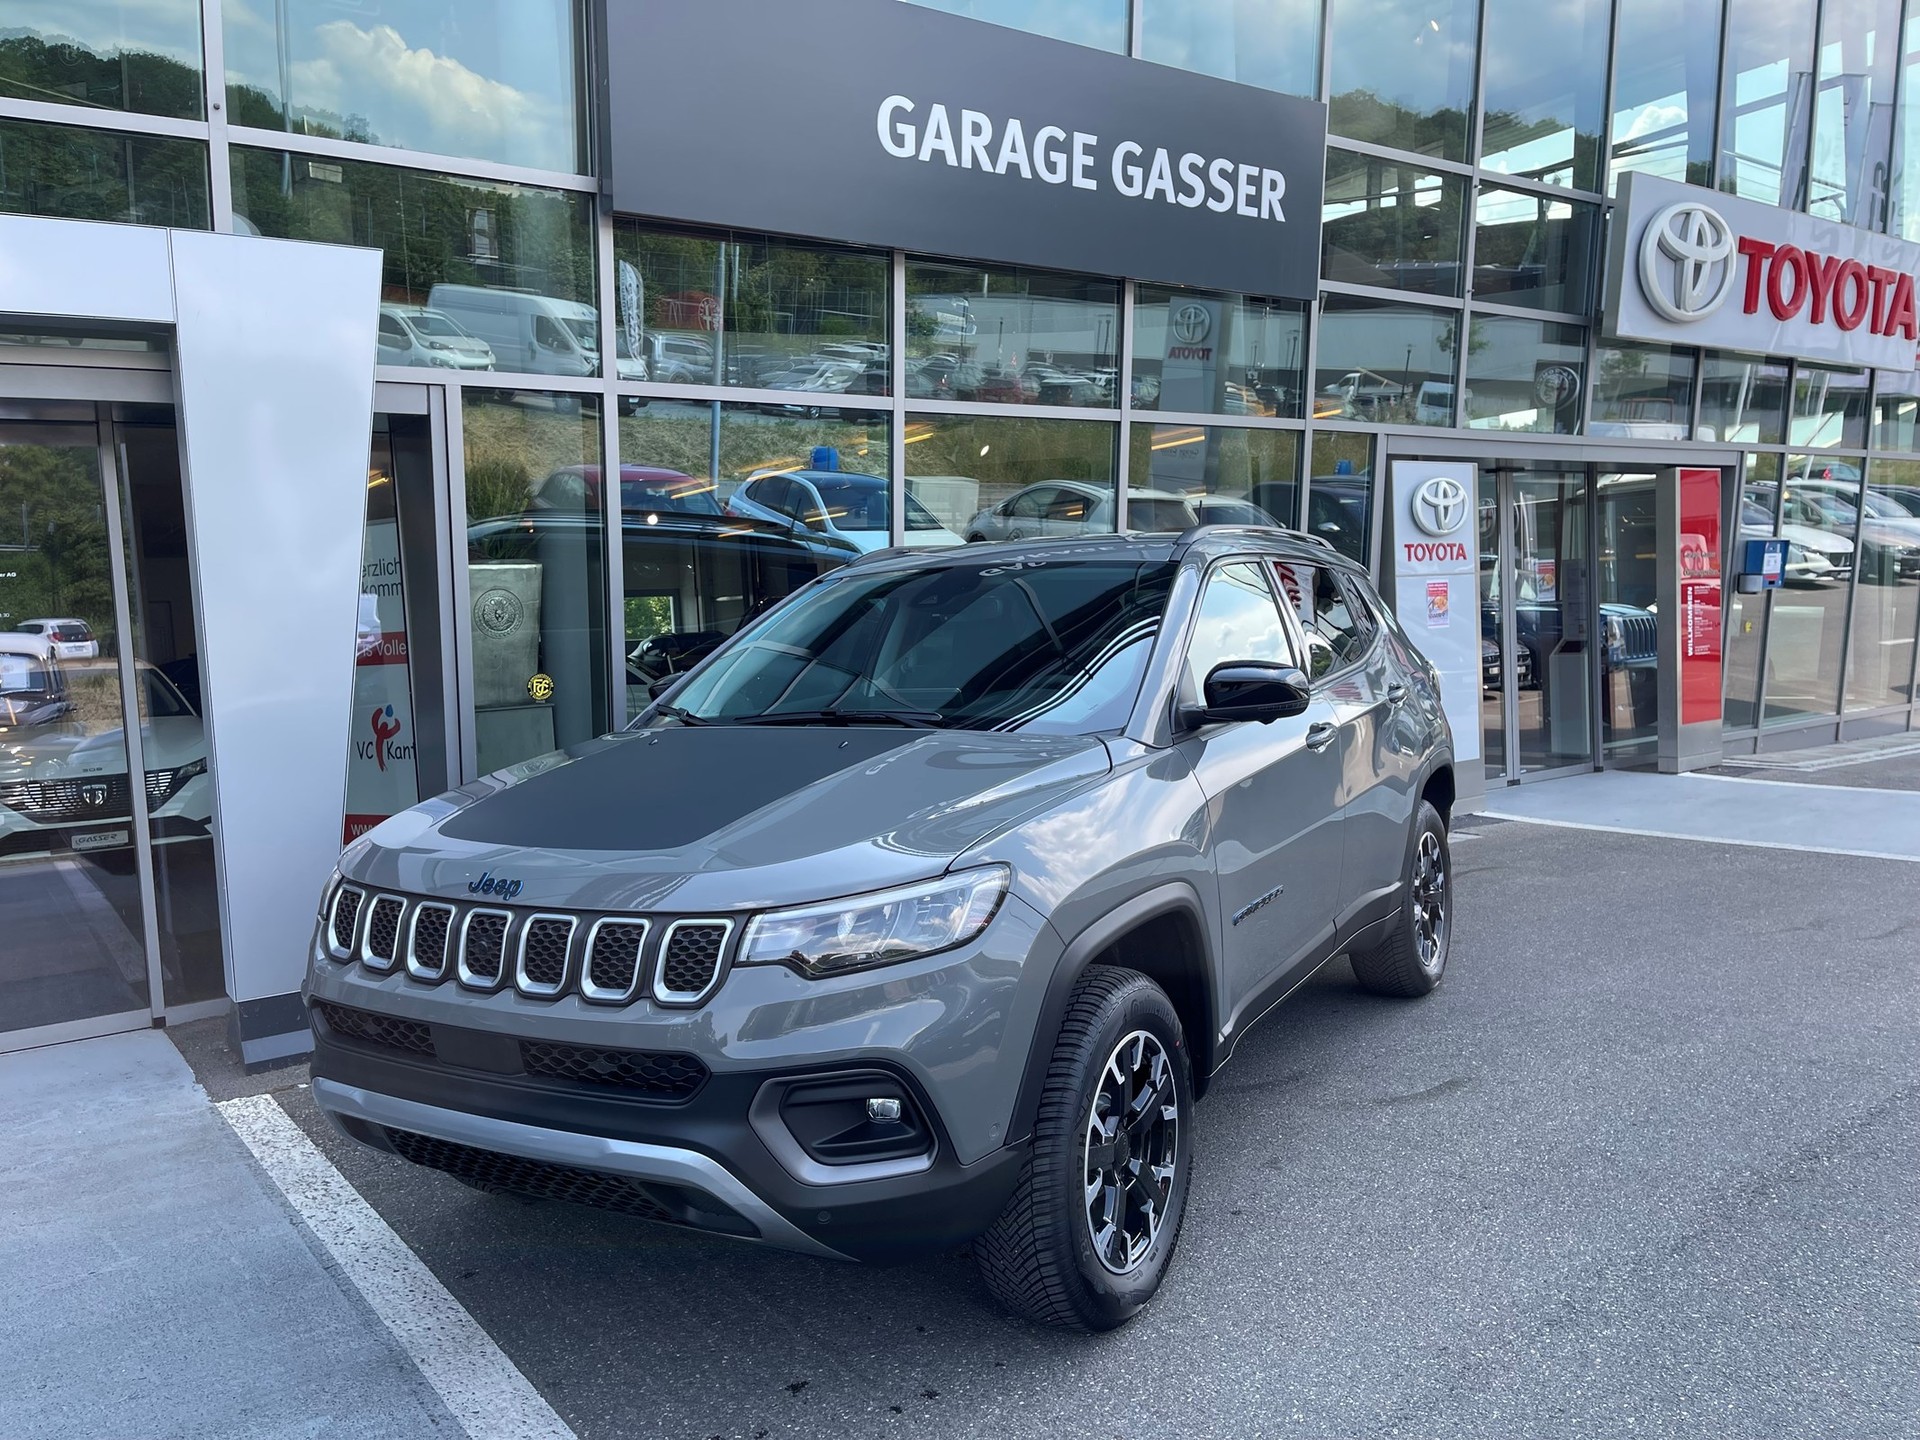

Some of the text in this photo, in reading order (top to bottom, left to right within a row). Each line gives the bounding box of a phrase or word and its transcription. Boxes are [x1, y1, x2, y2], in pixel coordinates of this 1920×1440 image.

[876, 94, 1287, 222] GARAGE GASSER
[1738, 235, 1917, 340] TOYOTA
[1404, 542, 1467, 562] TOYOTA
[376, 639, 407, 656] Volle
[357, 741, 374, 760] VC
[468, 871, 524, 901] Jeep
